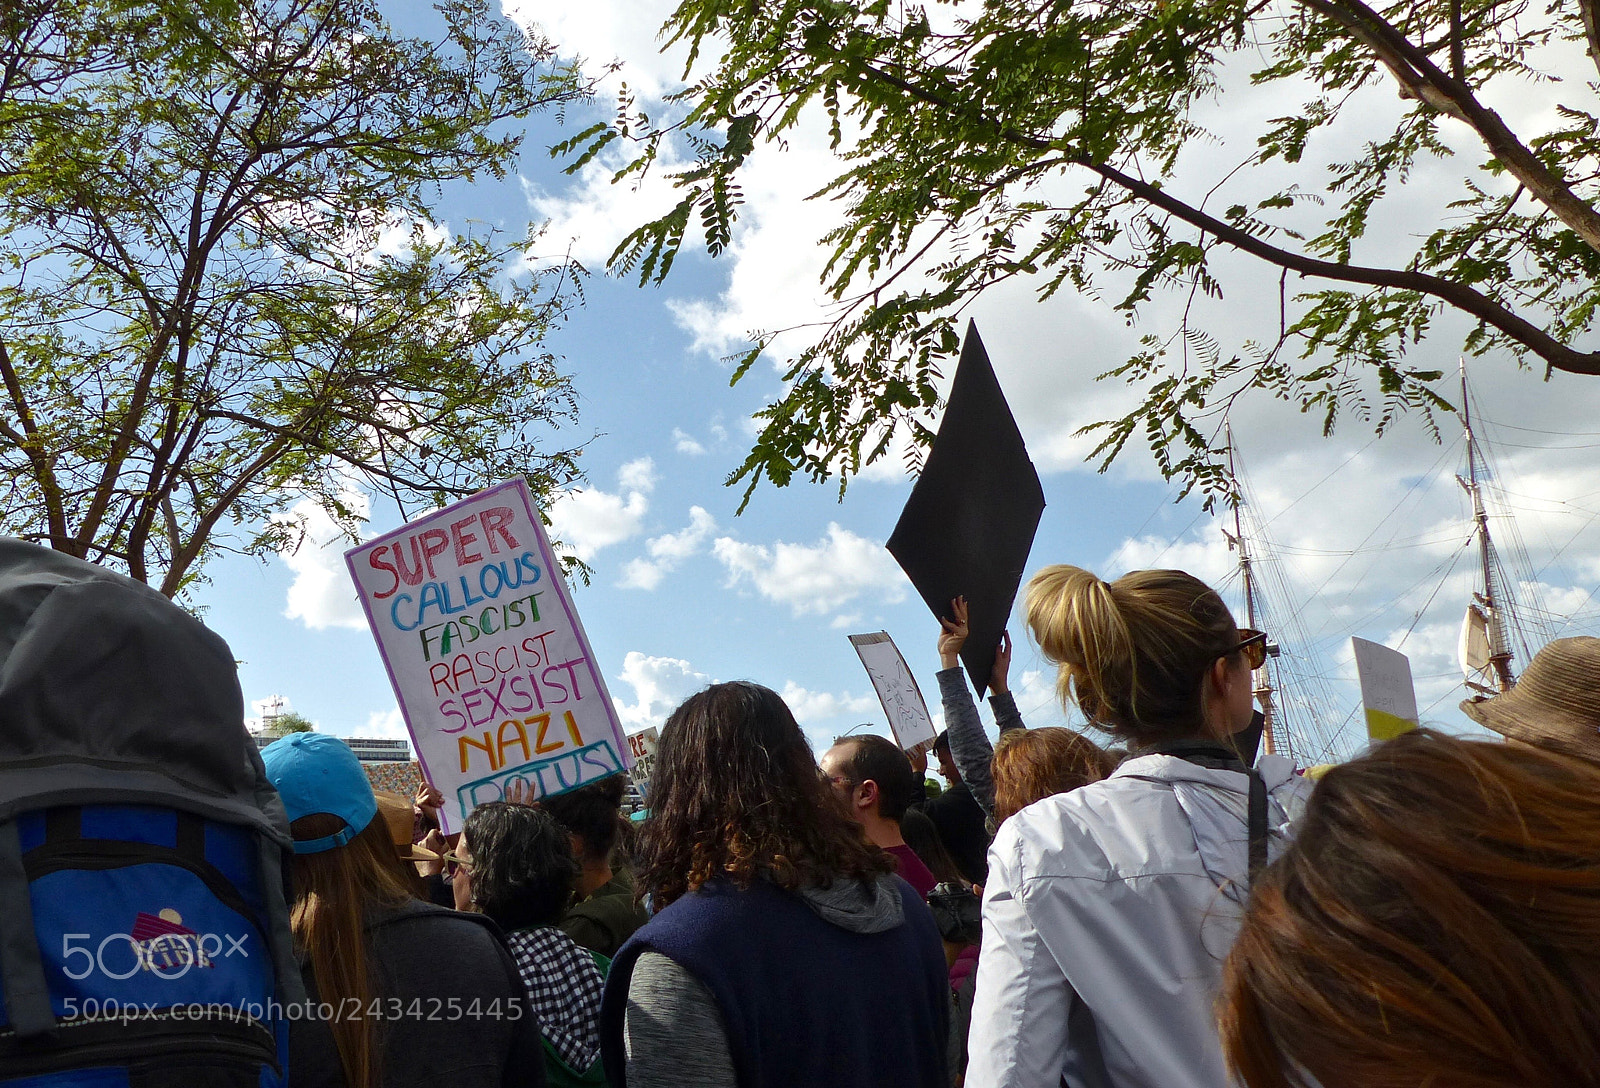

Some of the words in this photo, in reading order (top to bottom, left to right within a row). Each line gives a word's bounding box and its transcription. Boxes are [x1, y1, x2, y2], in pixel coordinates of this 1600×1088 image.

[369, 506, 521, 599] SUPER
[390, 551, 542, 632] CALLOUS
[419, 591, 545, 662] FASCIST
[429, 630, 556, 697] RASCIST
[437, 657, 589, 734] SEXSIST
[458, 710, 585, 773] NAZI
